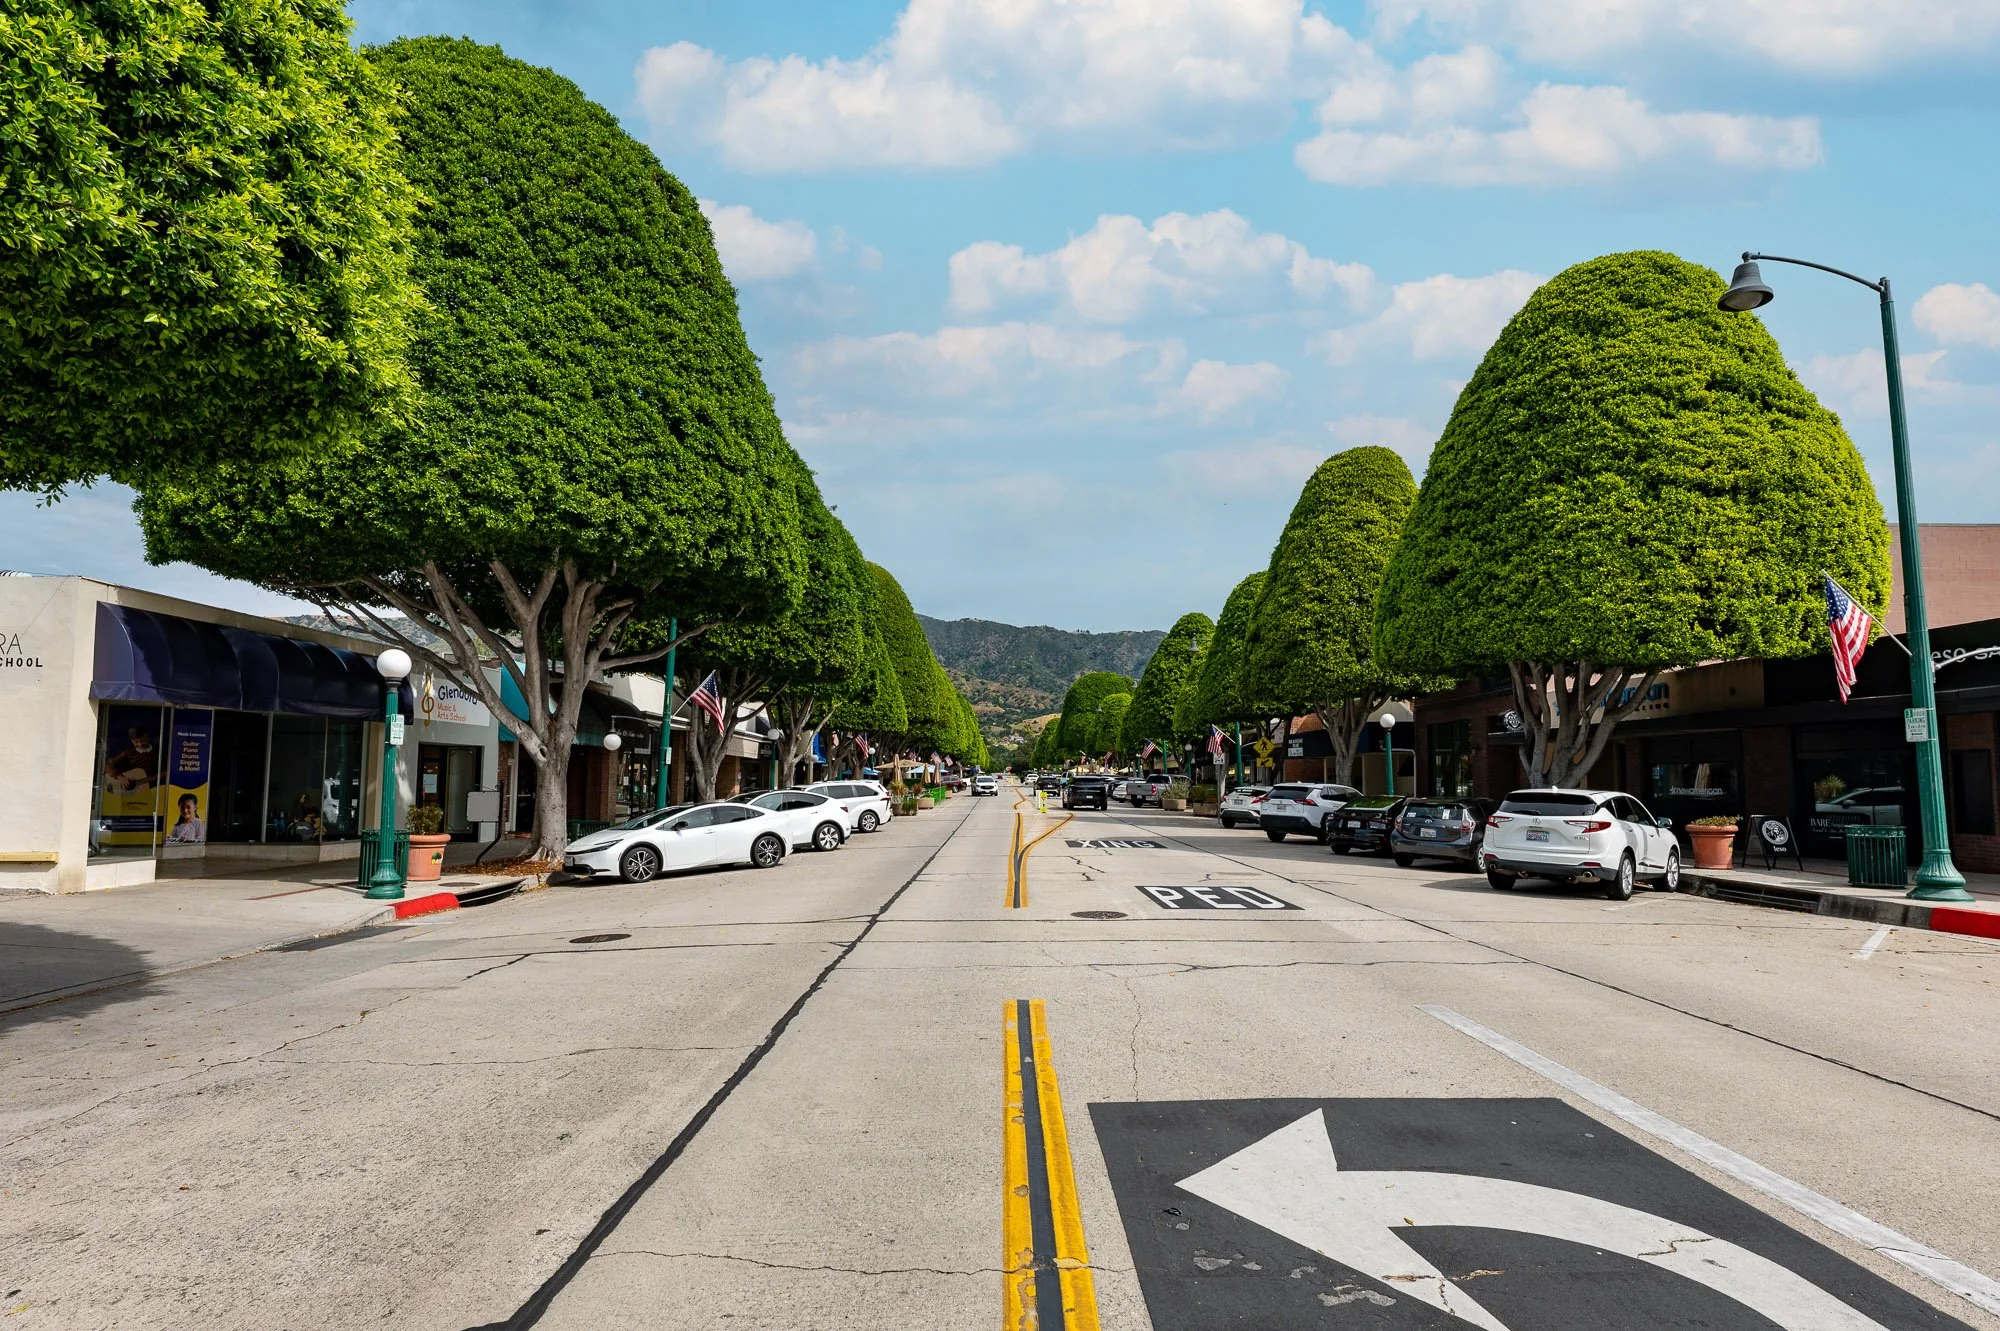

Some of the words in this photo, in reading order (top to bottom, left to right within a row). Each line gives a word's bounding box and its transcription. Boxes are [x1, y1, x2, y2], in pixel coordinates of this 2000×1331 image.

[1930, 648, 1967, 662] eso
[437, 703, 452, 711] Music
[437, 711, 449, 720] Arts
[450, 712, 467, 722] School
[1075, 840, 1156, 849] XING
[1143, 886, 1286, 909] PED
